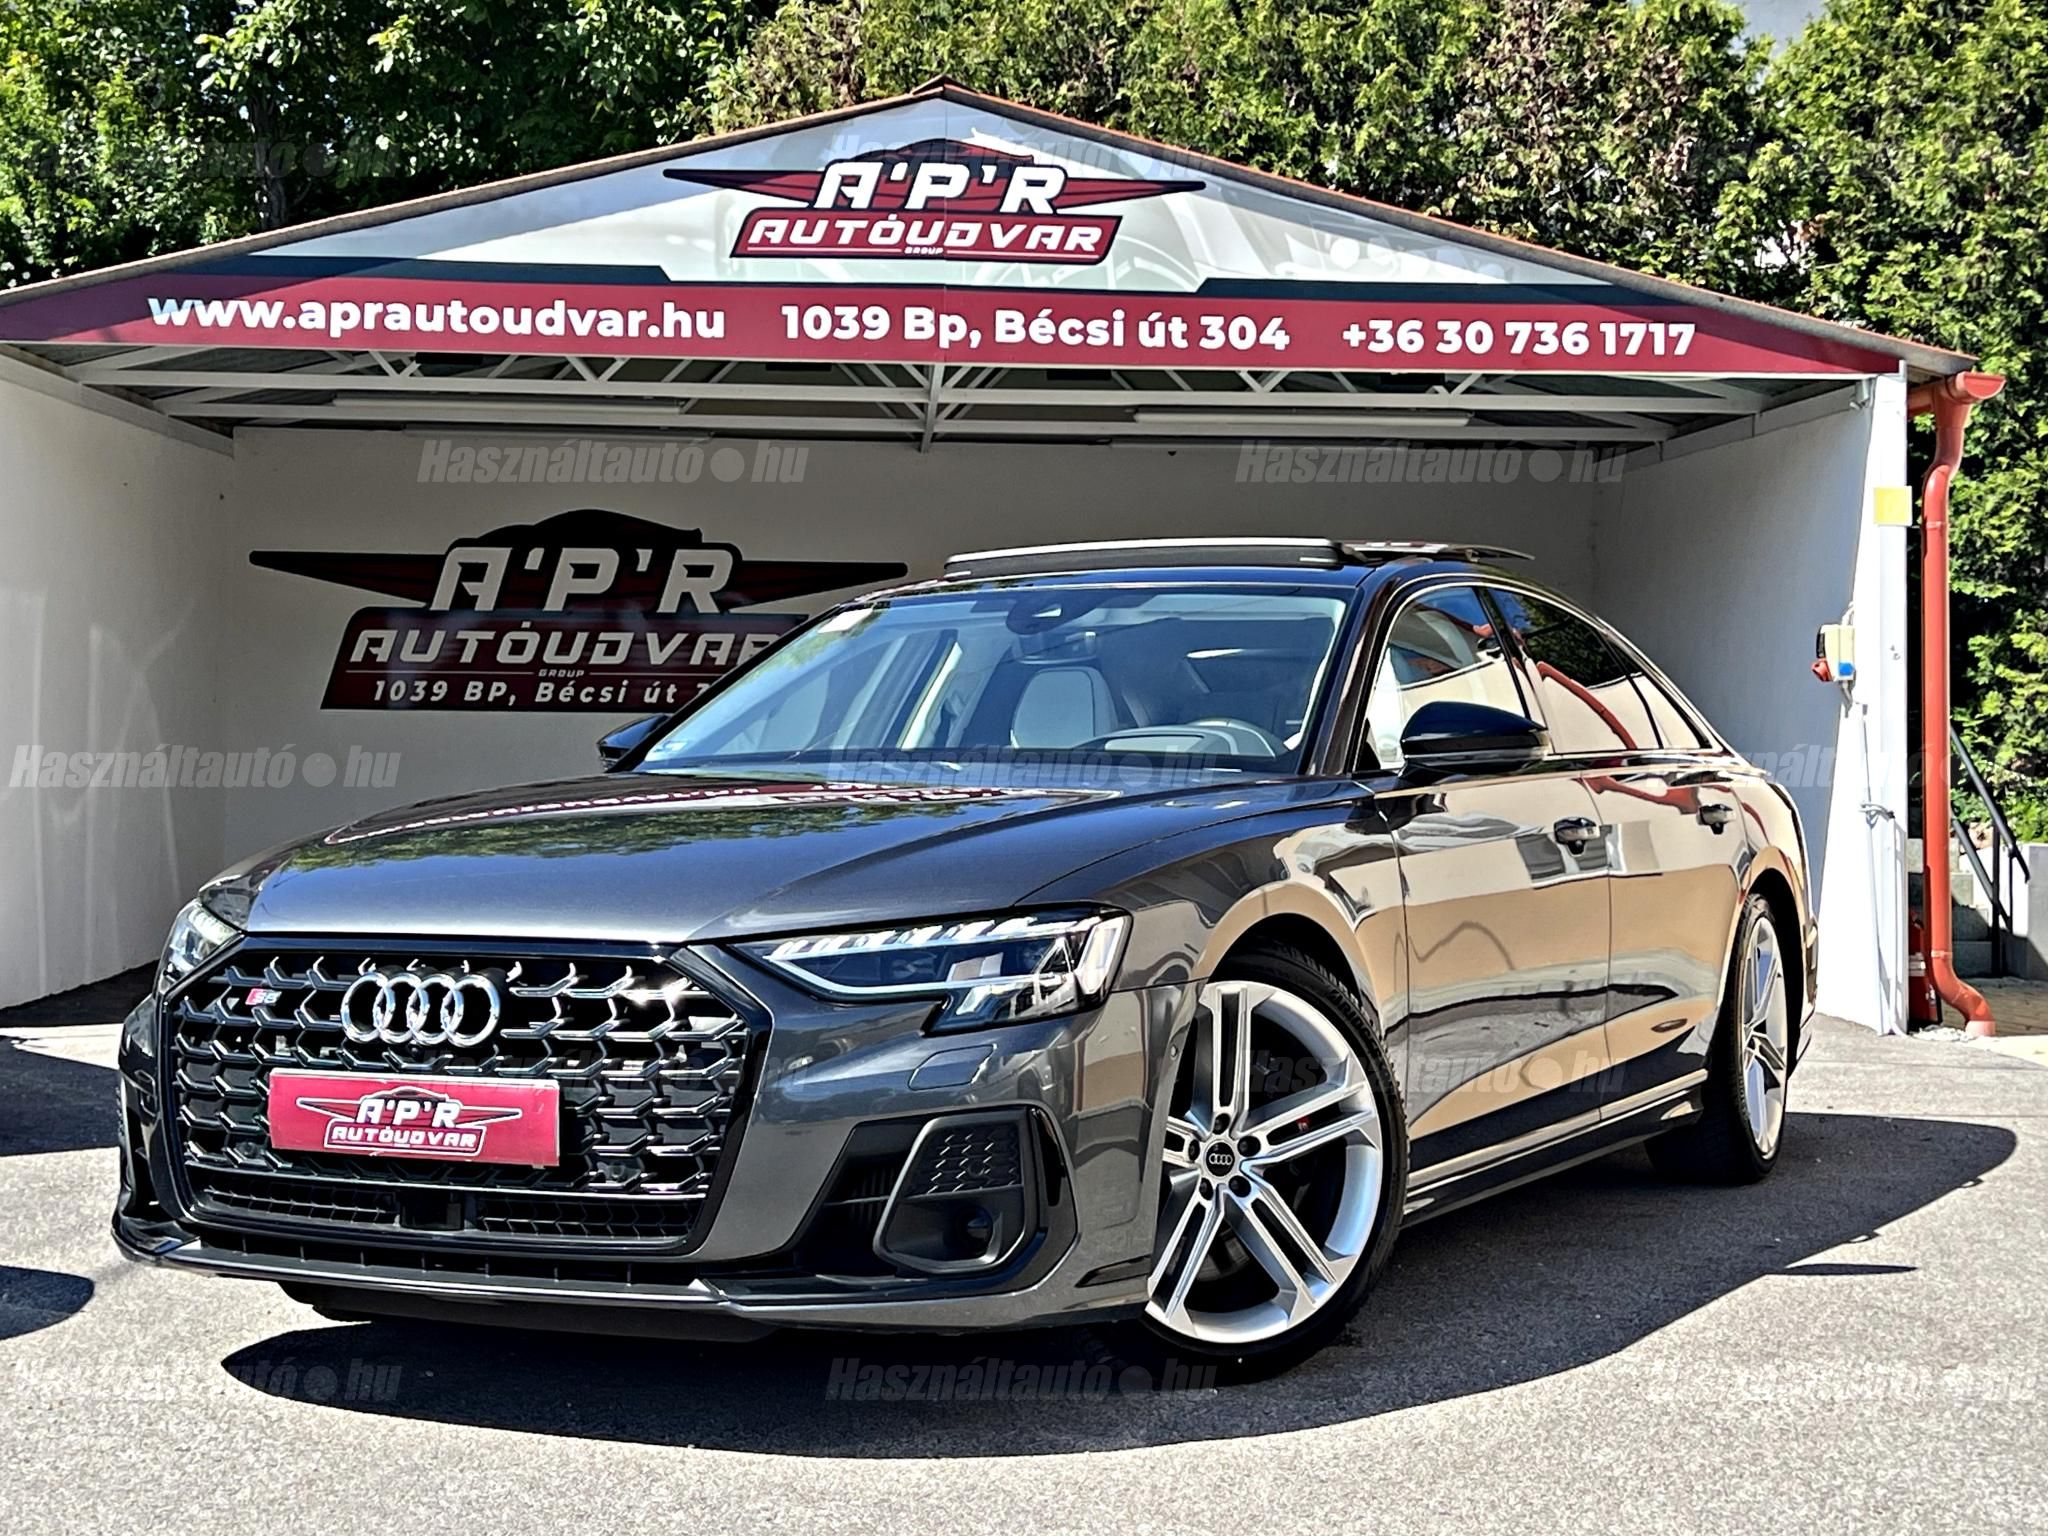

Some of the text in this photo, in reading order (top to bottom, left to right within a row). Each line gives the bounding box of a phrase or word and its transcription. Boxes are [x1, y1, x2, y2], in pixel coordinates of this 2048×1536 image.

[748, 213, 1102, 252] AUTÓUDVAR
[148, 297, 1695, 356] www.aprautoudvar.hu 1039 Bp, Bécsi út 304 +36 30 736 1717
[539, 669, 584, 678] GROUP
[374, 680, 448, 701] 1039
[464, 681, 516, 706] BP,
[535, 680, 629, 703] Bécsi
[644, 683, 677, 703] út
[331, 1126, 476, 1147] AUTÓUDVAR
